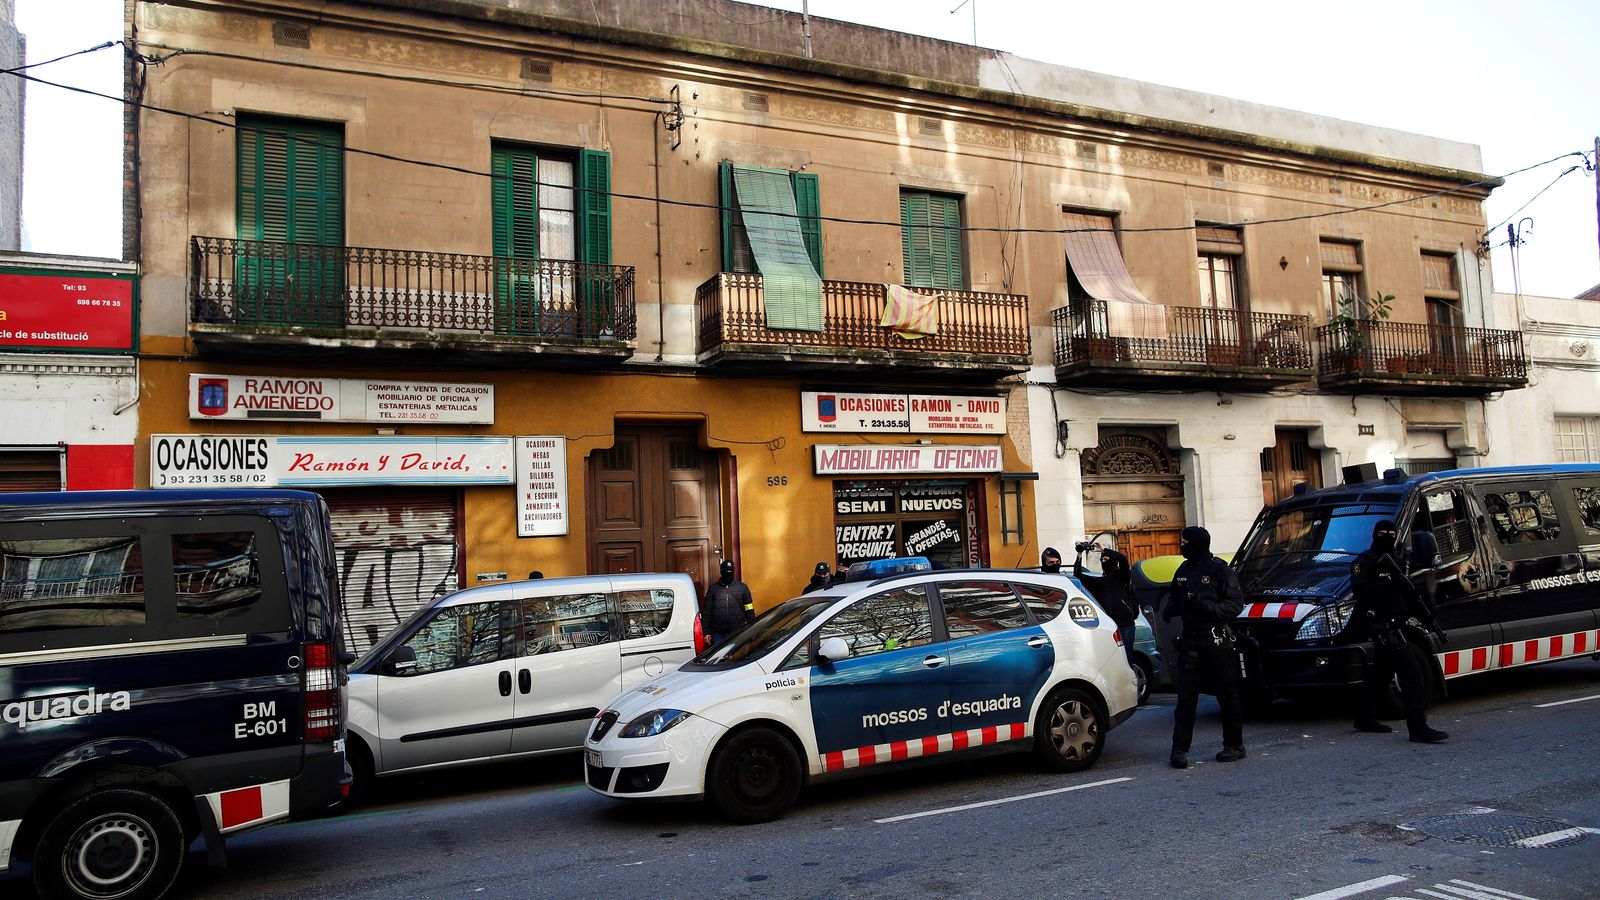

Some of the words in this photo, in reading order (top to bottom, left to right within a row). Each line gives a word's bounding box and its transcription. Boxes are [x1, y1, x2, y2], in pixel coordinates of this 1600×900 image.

[15, 331, 28, 339] de
[31, 331, 89, 341] substitució
[245, 379, 322, 396] RAMON
[233, 394, 334, 410] AMENEDO
[840, 398, 906, 412] OCASIONES
[912, 399, 952, 413] RAMON
[968, 400, 1000, 414] DAVID
[859, 420, 867, 428] T.
[157, 438, 268, 471] OCASIONES
[288, 453, 369, 472] Ramón
[820, 450, 920, 470] MOBILIARIO
[934, 450, 998, 469] OFICINA
[170, 476, 184, 484] 93
[188, 475, 208, 484] 231
[213, 475, 226, 483] 35
[253, 474, 266, 482] 02
[767, 476, 788, 487] 596
[837, 500, 886, 514] SEMI
[901, 498, 963, 512] NUEVOS
[524, 512, 562, 521] ARCHIVADORES
[909, 520, 947, 545] GRANDES
[1530, 574, 1573, 590] mossos
[1072, 605, 1094, 618] 112
[0, 687, 131, 728] quadra
[243, 701, 276, 720] BM
[862, 706, 928, 728] mossos
[938, 693, 1022, 719] d'esquadra
[234, 718, 288, 740] E-601
